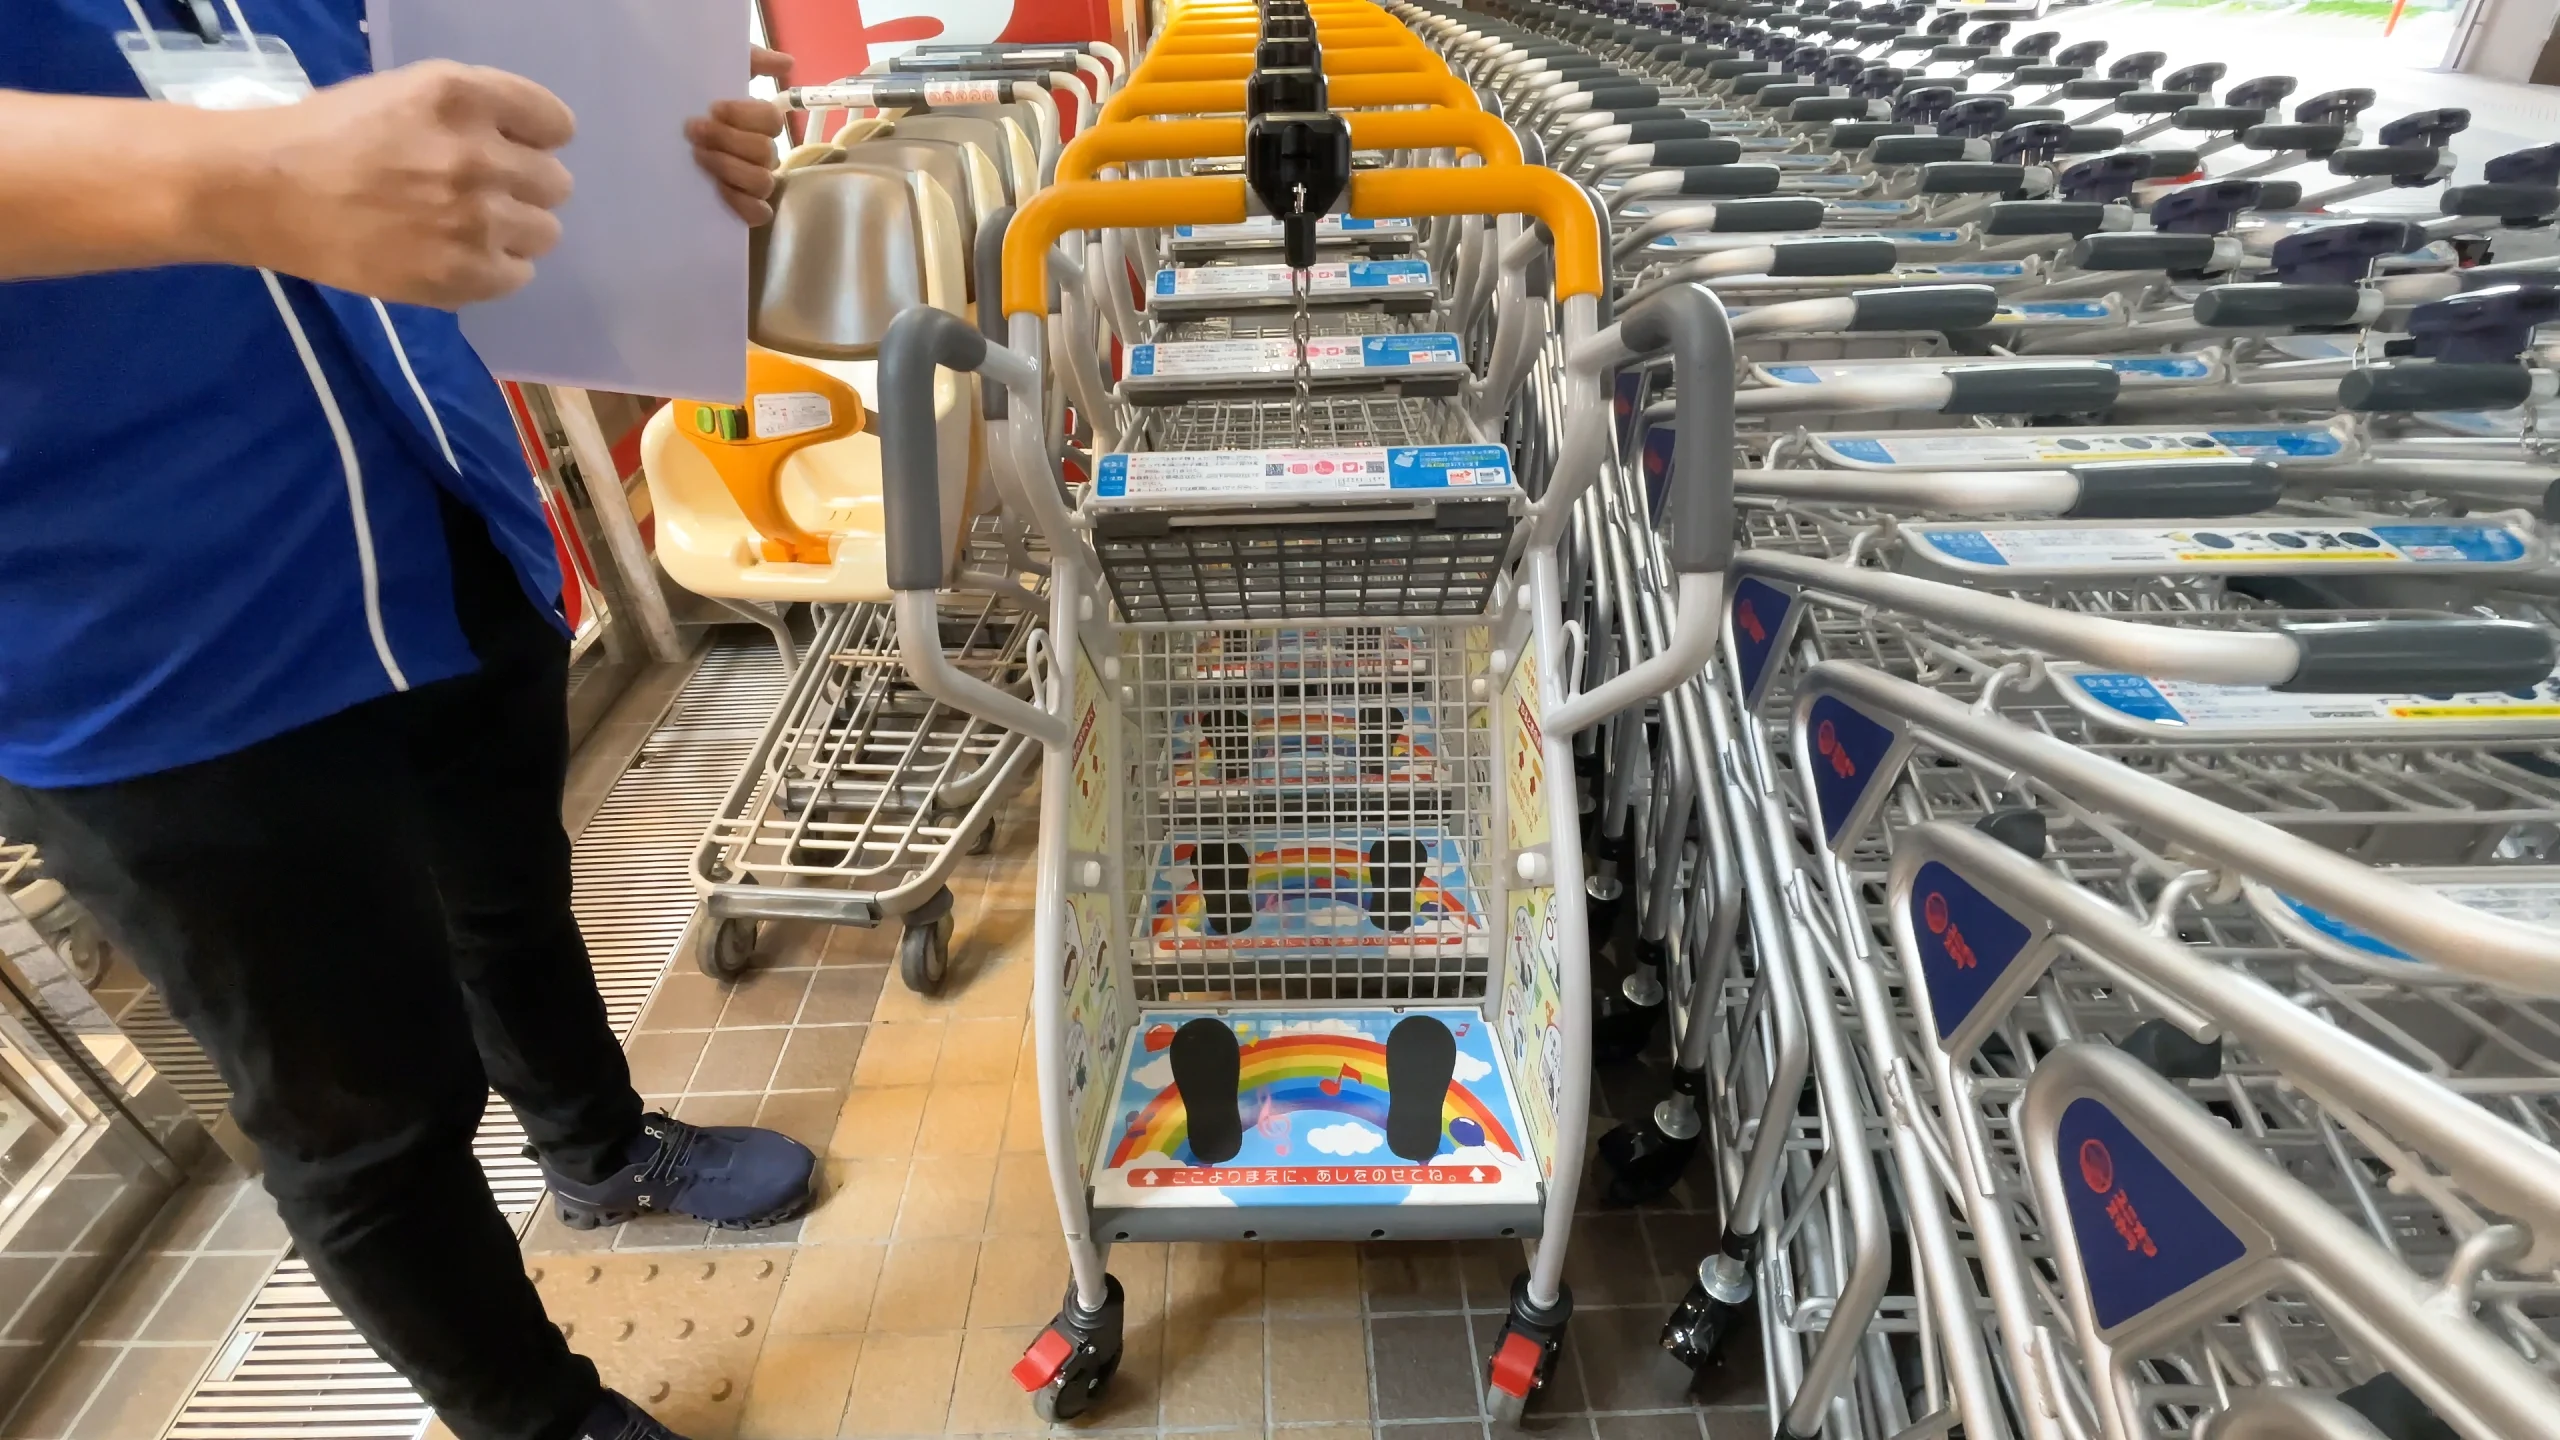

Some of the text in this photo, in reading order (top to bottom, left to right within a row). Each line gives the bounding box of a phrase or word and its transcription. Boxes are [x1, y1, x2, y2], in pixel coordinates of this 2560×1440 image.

[1172, 1168, 1457, 1185] ここよりまえに、あしをのせてね。
